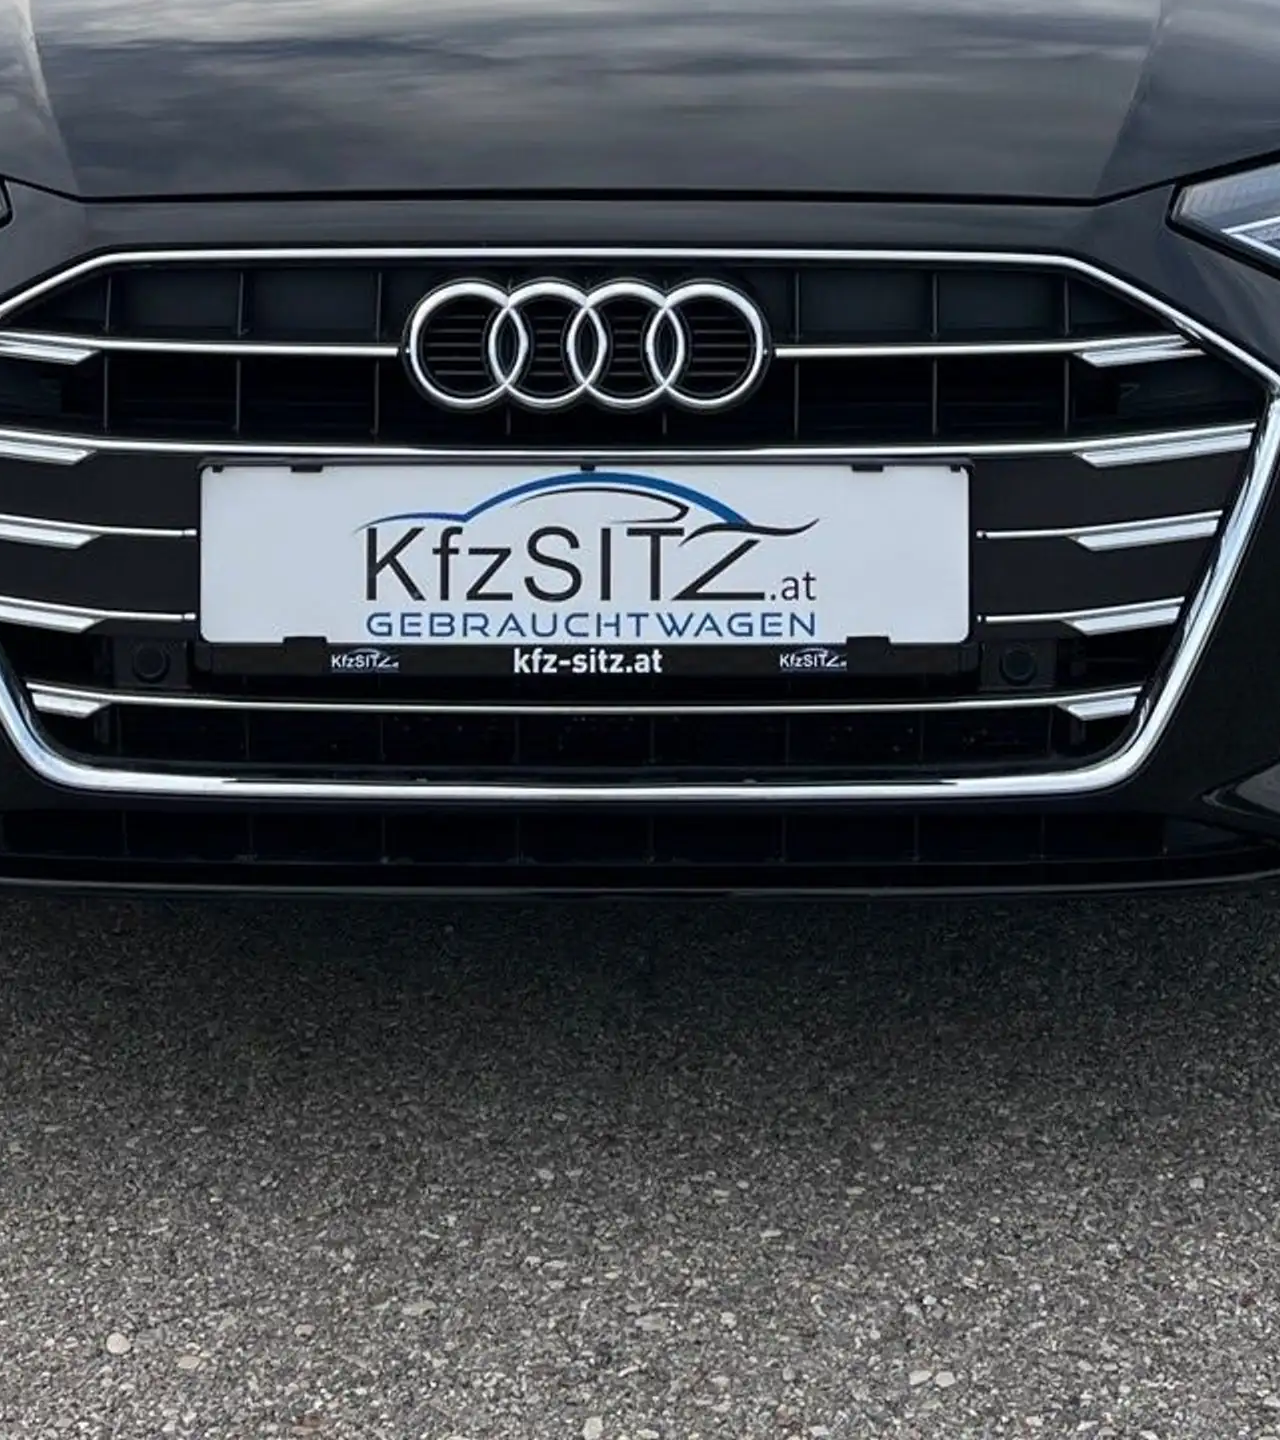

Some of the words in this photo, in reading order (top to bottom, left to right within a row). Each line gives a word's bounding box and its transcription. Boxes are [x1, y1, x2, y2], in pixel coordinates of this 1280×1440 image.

[365, 525, 817, 602] KfzSITZ.at
[366, 611, 816, 638] GEBRAUCHTWAGEN
[513, 647, 663, 674] kfz-sitz.at
